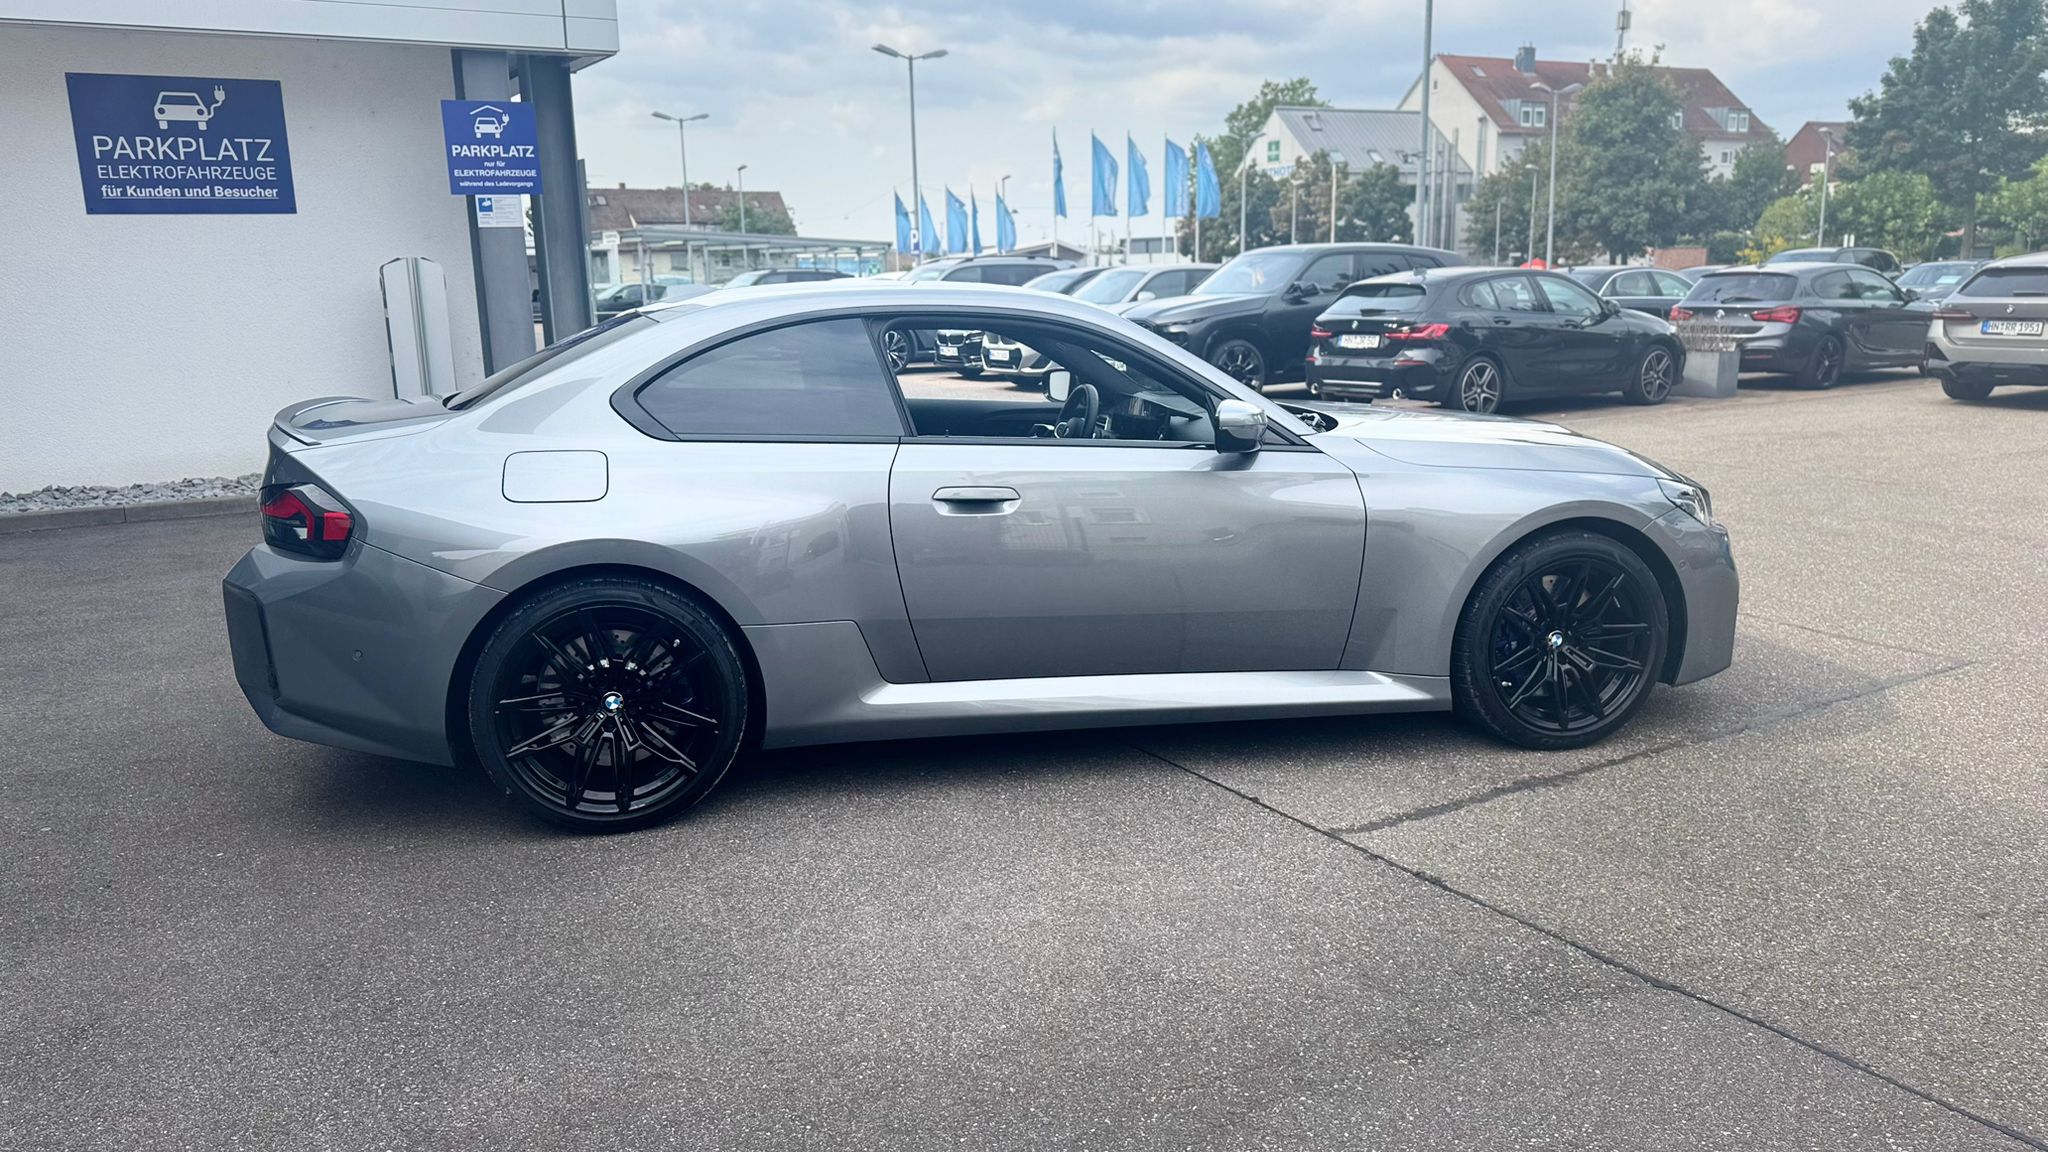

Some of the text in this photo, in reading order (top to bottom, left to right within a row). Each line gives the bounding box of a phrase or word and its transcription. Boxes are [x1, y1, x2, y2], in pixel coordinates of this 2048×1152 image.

[93, 135, 275, 162] PARKPLATZ
[451, 144, 535, 158] PARKPLATZ
[97, 164, 277, 181] ELEKTROFAHRZEUGE
[454, 169, 537, 177] ELEKTROFAHRZEUGE
[101, 184, 279, 198] für Kunden und Besucher
[1988, 321, 1999, 331] HN
